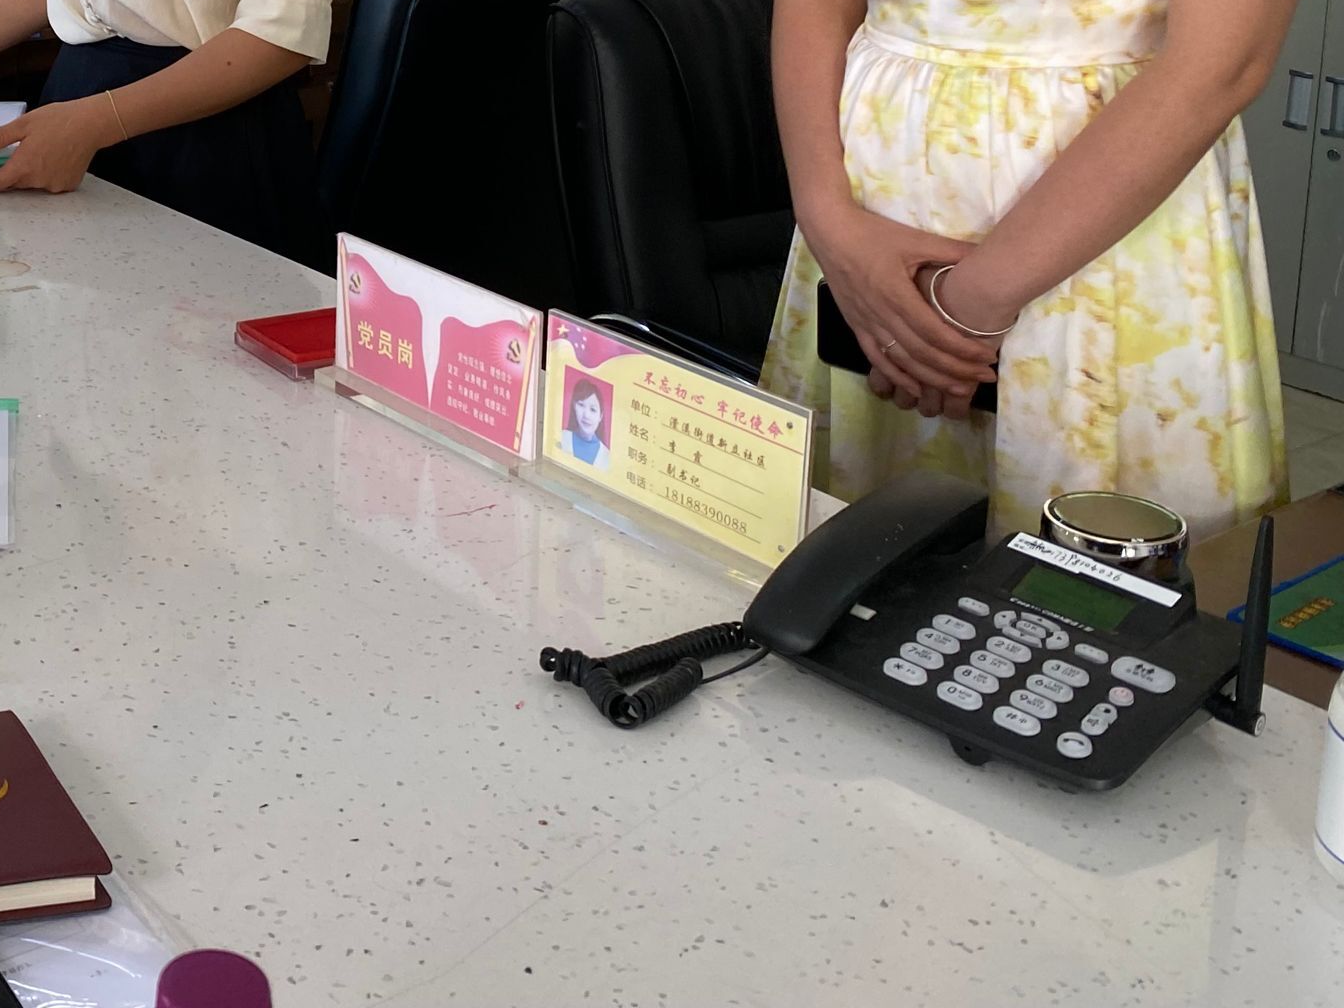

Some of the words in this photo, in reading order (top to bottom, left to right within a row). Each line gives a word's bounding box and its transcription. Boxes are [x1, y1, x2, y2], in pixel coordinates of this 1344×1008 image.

[358, 320, 414, 369] 党员岗
[643, 372, 705, 405] 不忘初心
[717, 400, 784, 439] 牢记使命
[665, 486, 747, 534] 18188390088
